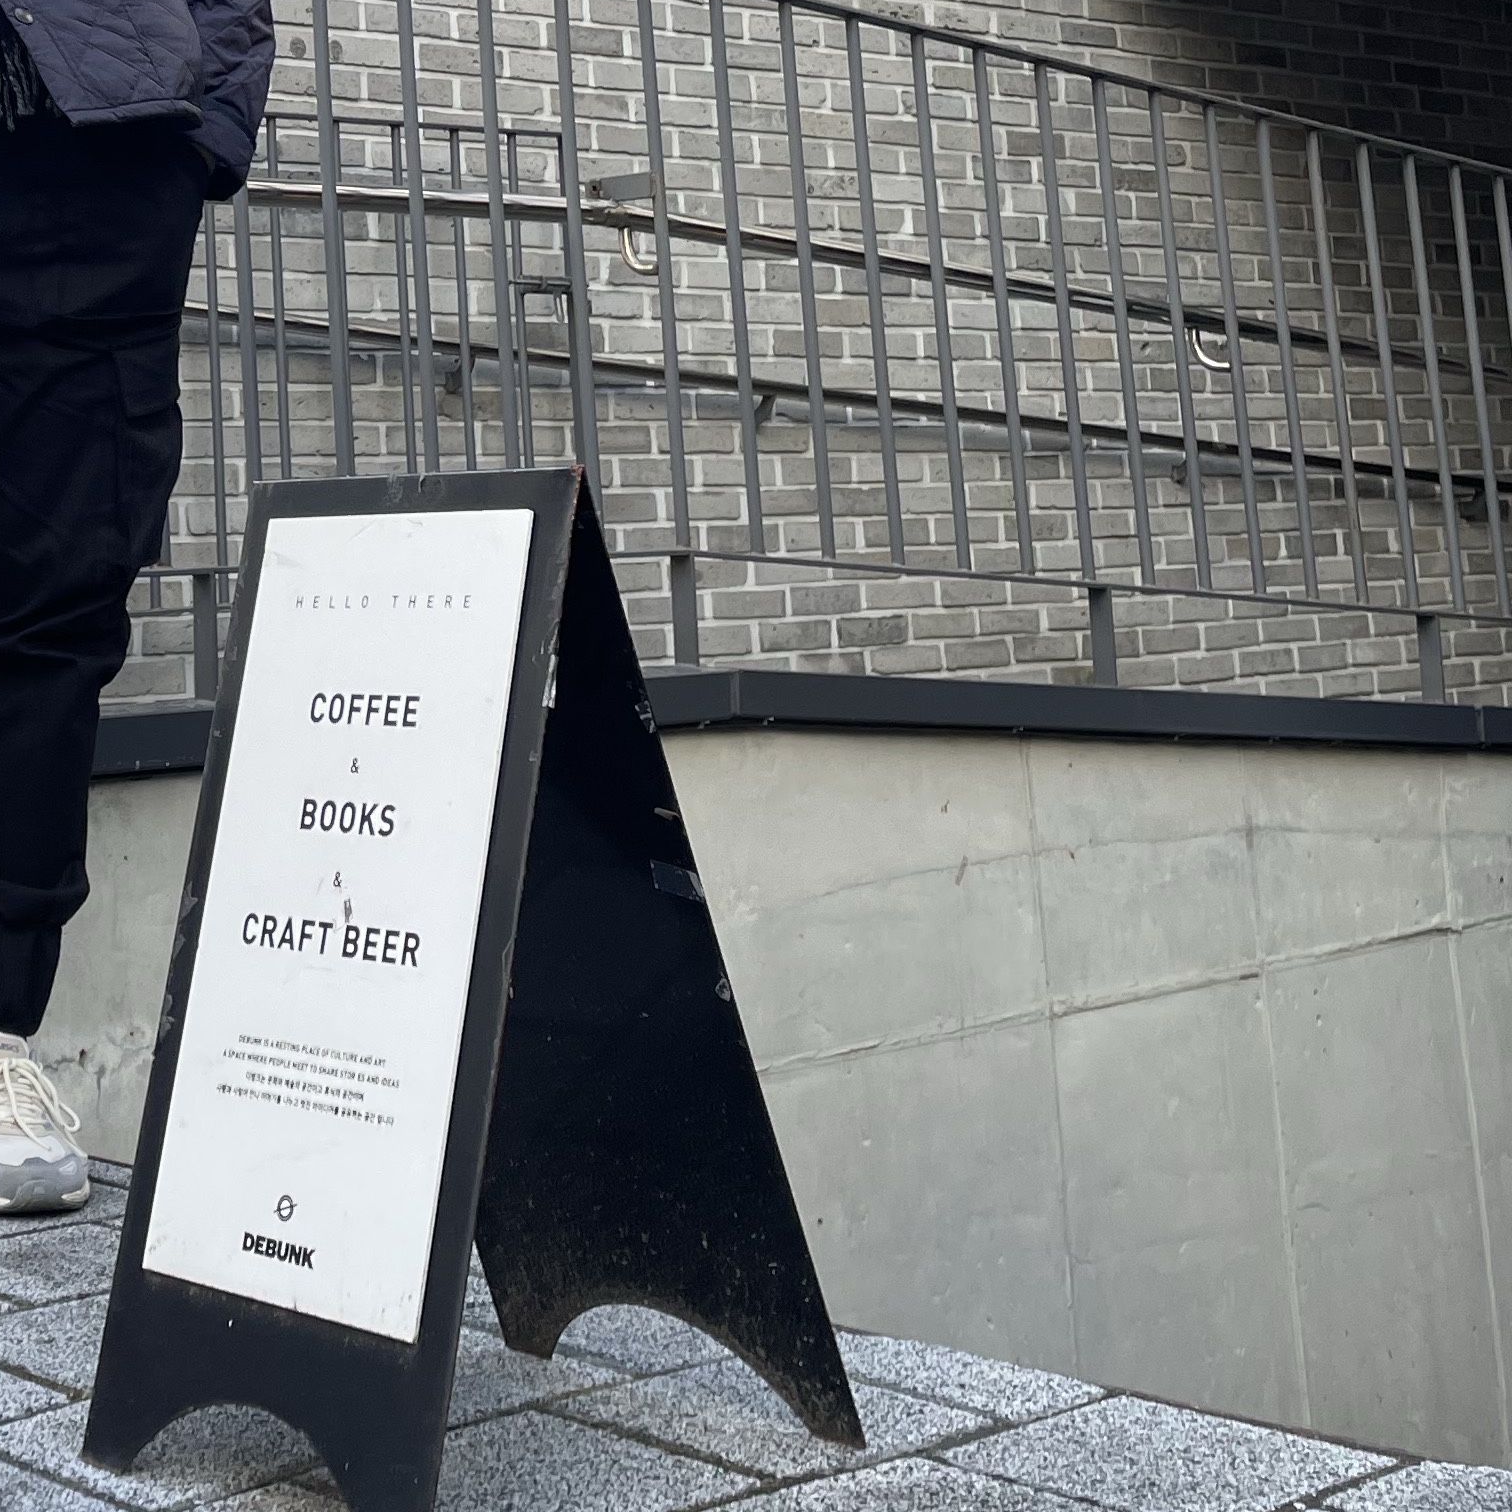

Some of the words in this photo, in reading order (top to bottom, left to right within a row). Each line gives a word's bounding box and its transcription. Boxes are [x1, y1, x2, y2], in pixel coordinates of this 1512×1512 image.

[295, 595, 370, 609] HELLO
[392, 595, 473, 609] THERE
[310, 693, 421, 727] COFFEE
[350, 757, 360, 774] &
[300, 798, 397, 837] BOOKS
[333, 872, 343, 888] &
[242, 913, 334, 955] CRAFT
[341, 924, 421, 968] BEER
[247, 1054, 268, 1064] WHERE
[269, 1057, 291, 1069] PEOPLE
[292, 1062, 308, 1072] MEET
[310, 1064, 317, 1073] TO
[319, 1067, 338, 1078] SHARE
[367, 1075, 380, 1085] AND
[301, 1045, 320, 1057] PLACE
[321, 1049, 329, 1058] OF
[330, 1050, 358, 1063] CULTURE
[359, 1055, 373, 1065] AND
[374, 1058, 386, 1068] ART
[242, 1231, 316, 1270] DEBUNK
